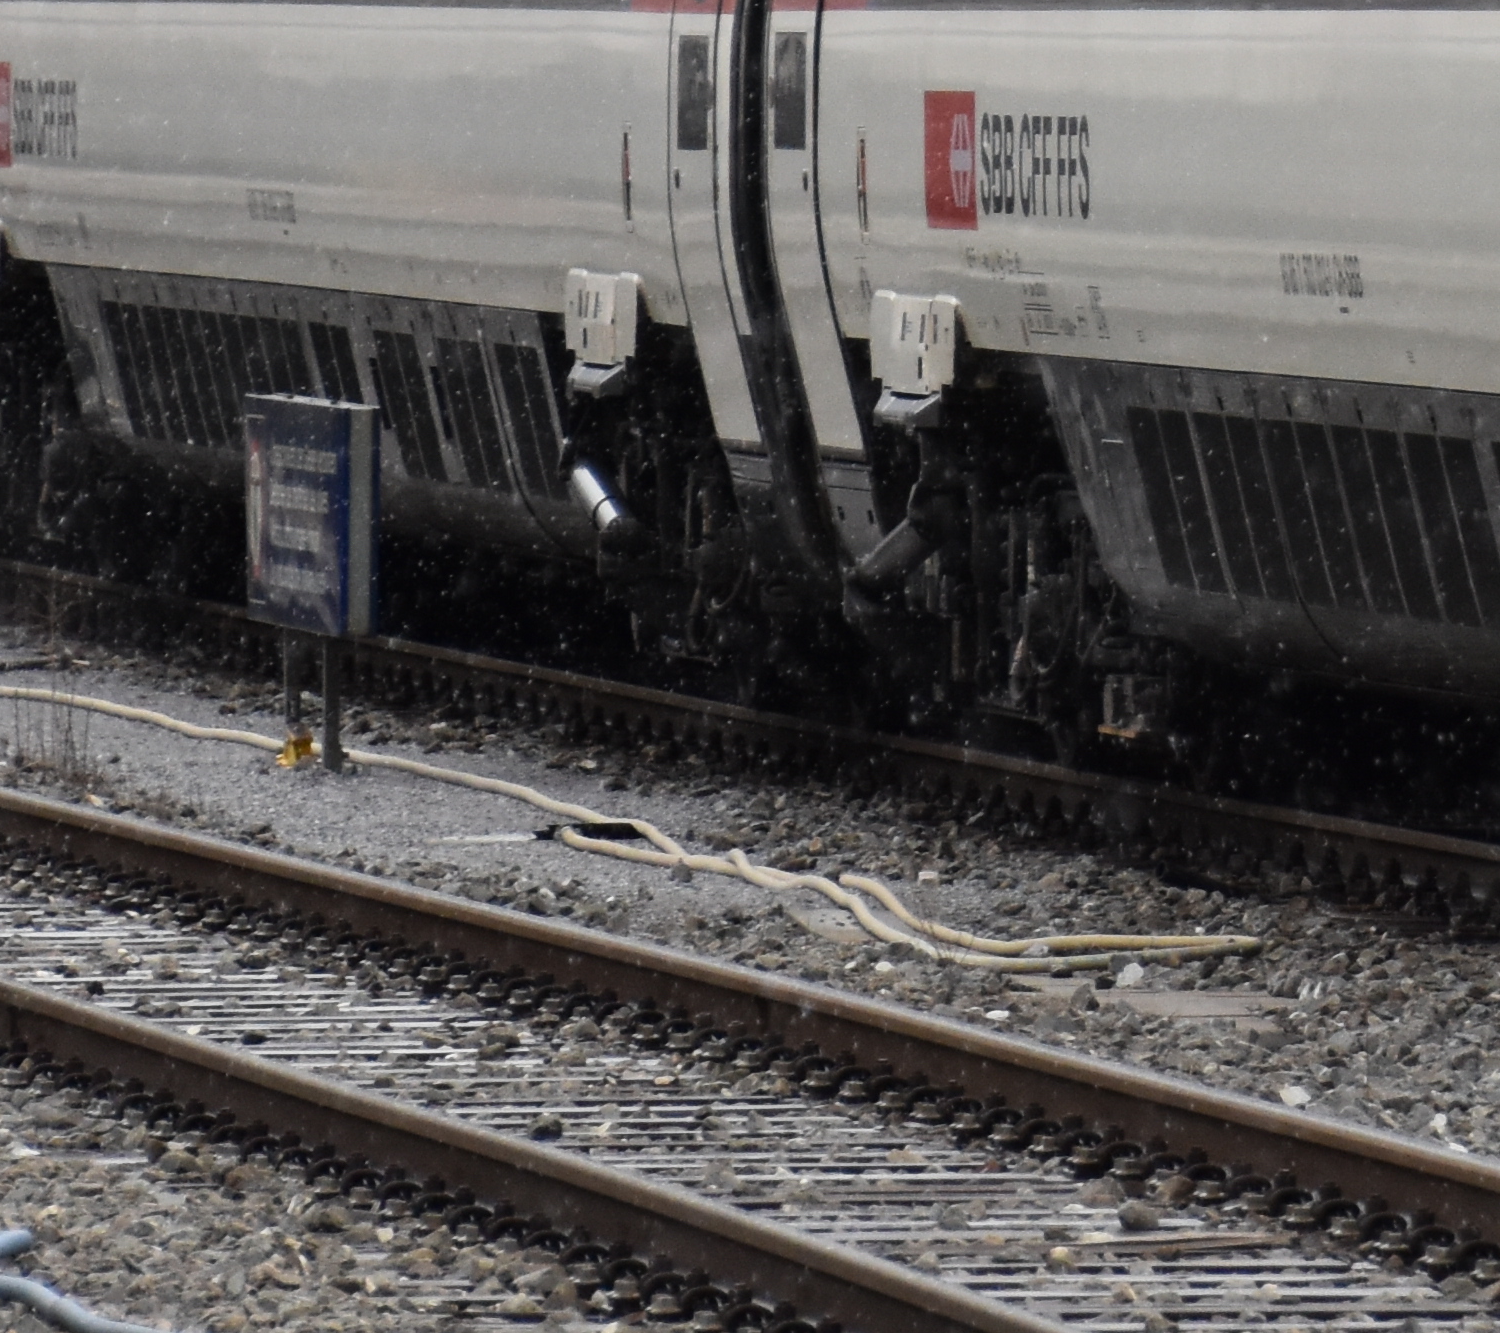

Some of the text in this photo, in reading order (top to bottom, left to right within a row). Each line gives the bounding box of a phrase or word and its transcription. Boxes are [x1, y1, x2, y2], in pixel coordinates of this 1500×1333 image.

[980, 112, 1090, 220] SBB CFF FFS
